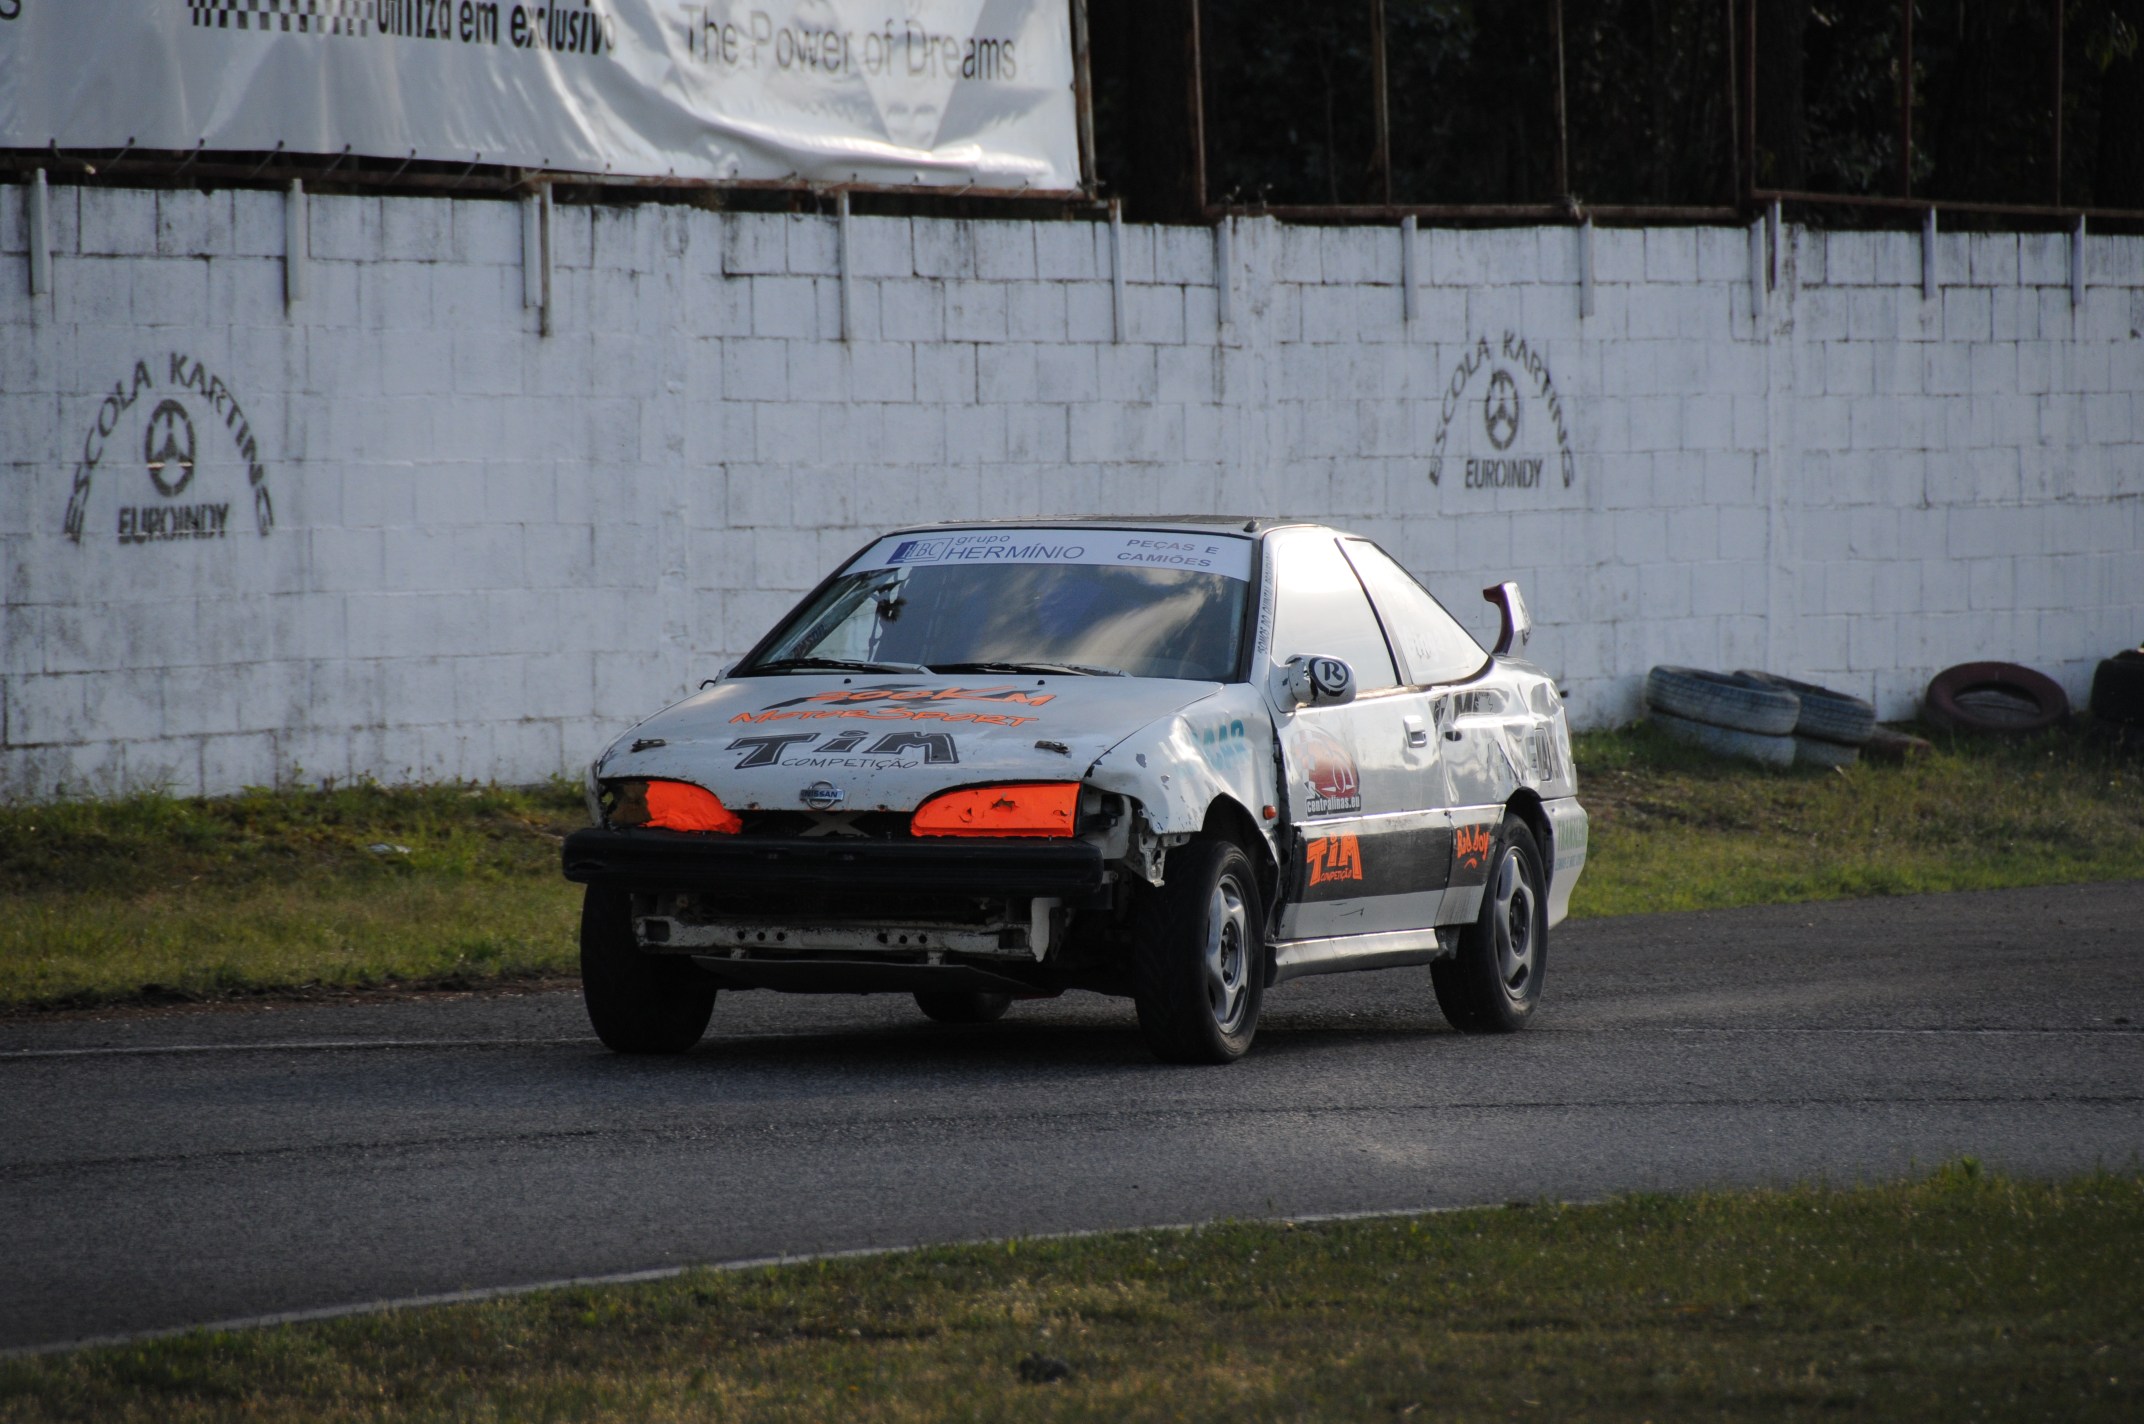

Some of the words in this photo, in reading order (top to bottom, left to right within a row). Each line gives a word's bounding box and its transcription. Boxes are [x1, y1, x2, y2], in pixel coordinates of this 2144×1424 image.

[459, 0, 499, 45] em
[680, 4, 739, 64] The
[750, 10, 853, 74] Power
[865, 18, 894, 77] of
[904, 18, 1017, 82] Dreams
[1465, 458, 1543, 489] EUROINDY
[957, 535, 1010, 545] grupo
[1127, 539, 1196, 552] PEÇAS
[1205, 546, 1219, 555] E
[945, 542, 1085, 560] HERMÍNIO
[1117, 552, 1212, 567] CAMIÕES
[1321, 661, 1344, 681] R
[780, 757, 920, 771] COMPETIÇÃO
[803, 790, 838, 798] NISSAN
[1307, 796, 1361, 813] centralinas.eu
